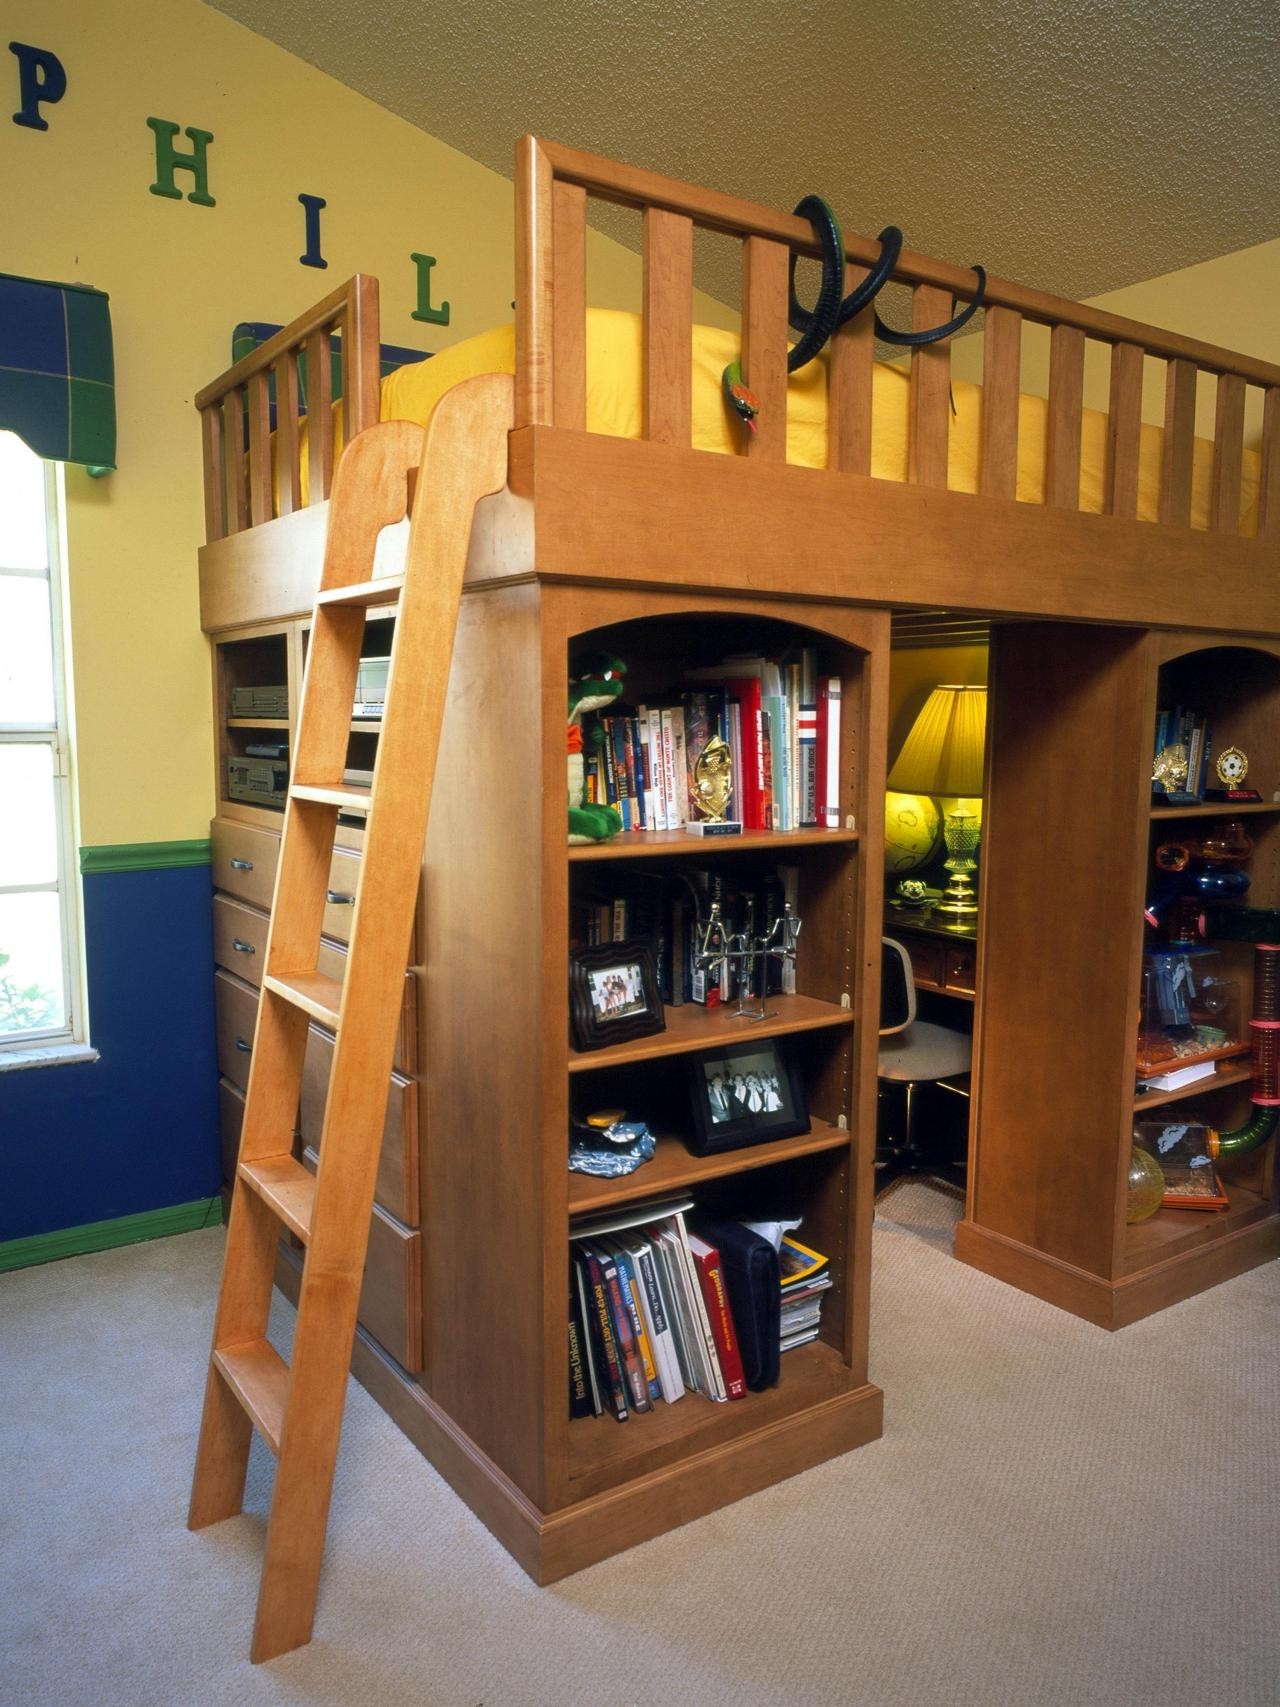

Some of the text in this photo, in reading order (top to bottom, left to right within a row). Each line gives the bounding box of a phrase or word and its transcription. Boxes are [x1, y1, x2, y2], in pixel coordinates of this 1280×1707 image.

[619, 1265, 633, 1305] MATHEMATICS
[708, 1269, 725, 1308] GEOGRAPHY
[598, 1308, 614, 1342] PULL-OUT
[569, 1322, 585, 1399] Into the Unknown
